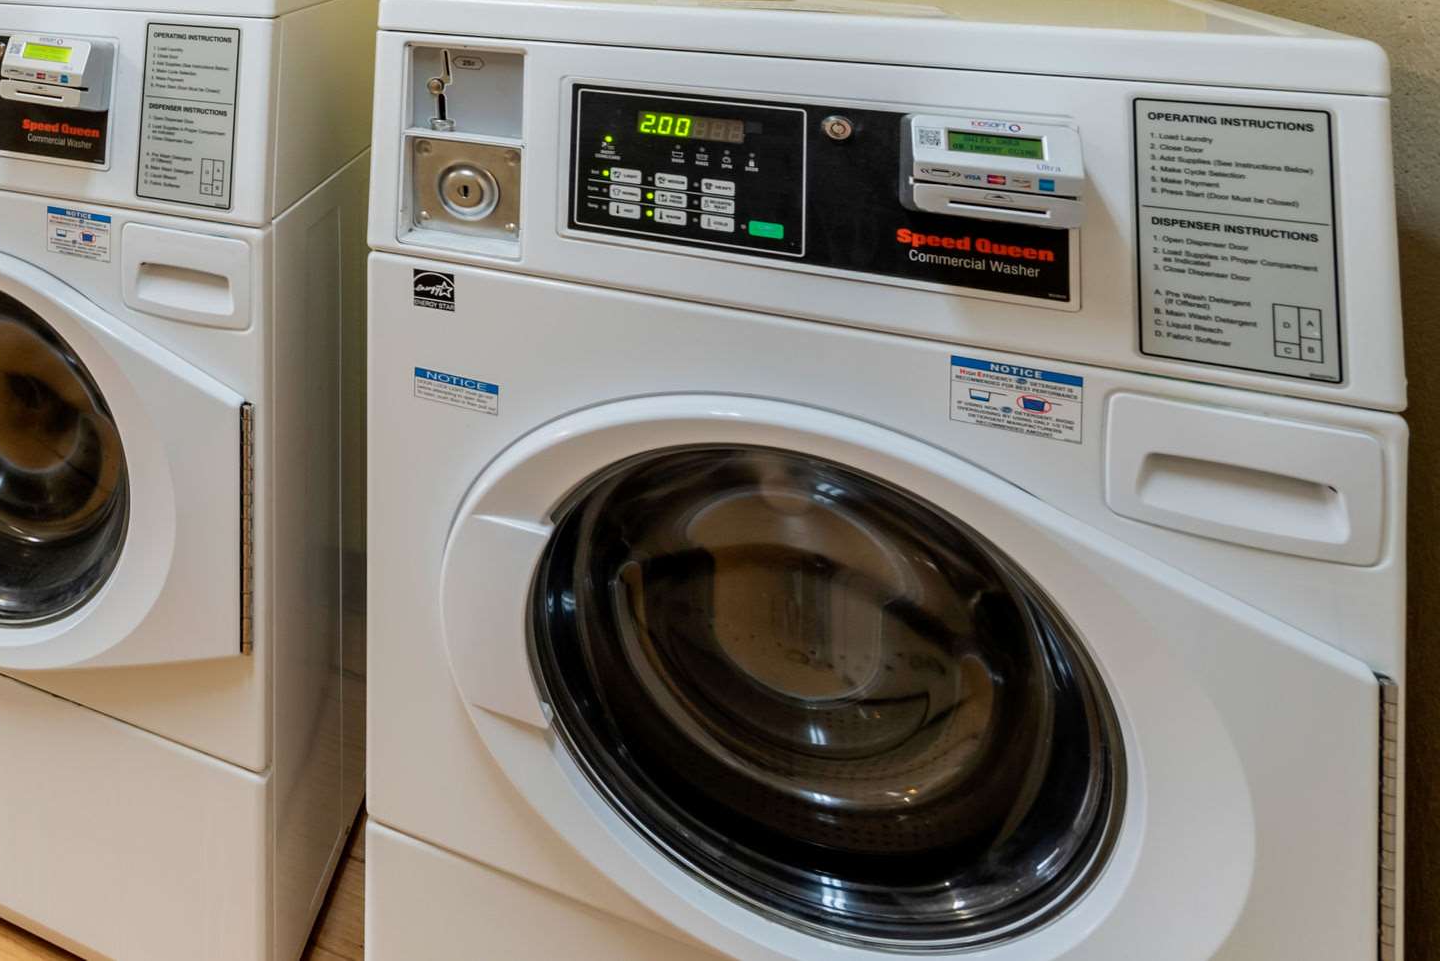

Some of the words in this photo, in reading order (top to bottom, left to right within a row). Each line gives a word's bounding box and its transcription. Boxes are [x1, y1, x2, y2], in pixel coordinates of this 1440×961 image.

[153, 31, 186, 40] OPERATING
[188, 35, 232, 43] INSTRUCTIONS
[183, 106, 227, 117] INSTRUCTIONS
[22, 119, 59, 133] Speed
[61, 123, 100, 138] Queen
[640, 114, 691, 136] 2.00
[1147, 111, 1217, 125] OPERATING
[1220, 117, 1314, 133] INSTRUCTIONS
[1159, 133, 1179, 141] Load
[1181, 134, 1213, 144] Laundry
[1160, 144, 1182, 152] Close
[1184, 145, 1204, 154] Door
[1160, 154, 1175, 162] Add
[1177, 156, 1211, 167] Supplies
[1235, 160, 1282, 172] Instructions
[1161, 166, 1182, 174] Make
[1184, 167, 1206, 178] Cycle
[1208, 169, 1246, 180] Selection
[1161, 177, 1182, 185] Make
[1184, 178, 1220, 189] Payment
[1161, 188, 1184, 197] Press
[1186, 190, 1205, 199] Start
[1231, 194, 1251, 203] Must
[1151, 216, 1220, 232] DISPENSER
[1224, 224, 1319, 243] INSTRUCTIONS
[896, 227, 971, 252] Speed
[975, 237, 1055, 262] Queen
[1162, 236, 1184, 245] Open
[1186, 237, 1227, 249] Dispenser
[1229, 242, 1249, 251] Door
[908, 249, 986, 271] Commercial
[989, 259, 1040, 278] Washer
[1162, 248, 1182, 256] Load
[1184, 250, 1219, 261] Supplies
[1230, 255, 1258, 266] Proper
[1260, 259, 1318, 272] Compartment
[1163, 265, 1186, 274] Close
[1188, 267, 1228, 279] Dispenser
[1230, 273, 1251, 282] Door
[1165, 290, 1180, 299] Pre
[1183, 292, 1206, 302] Wash
[1208, 295, 1251, 307] Detergent
[1165, 309, 1186, 318] Main
[1189, 311, 1212, 321] Wash
[1214, 314, 1257, 327] Detergent
[1307, 319, 1314, 327] A
[1166, 332, 1192, 342] Fabric
[1195, 335, 1231, 347] Softener
[1284, 347, 1292, 355] C
[990, 363, 1043, 379] NOTICE
[426, 371, 488, 391] NOTICE
